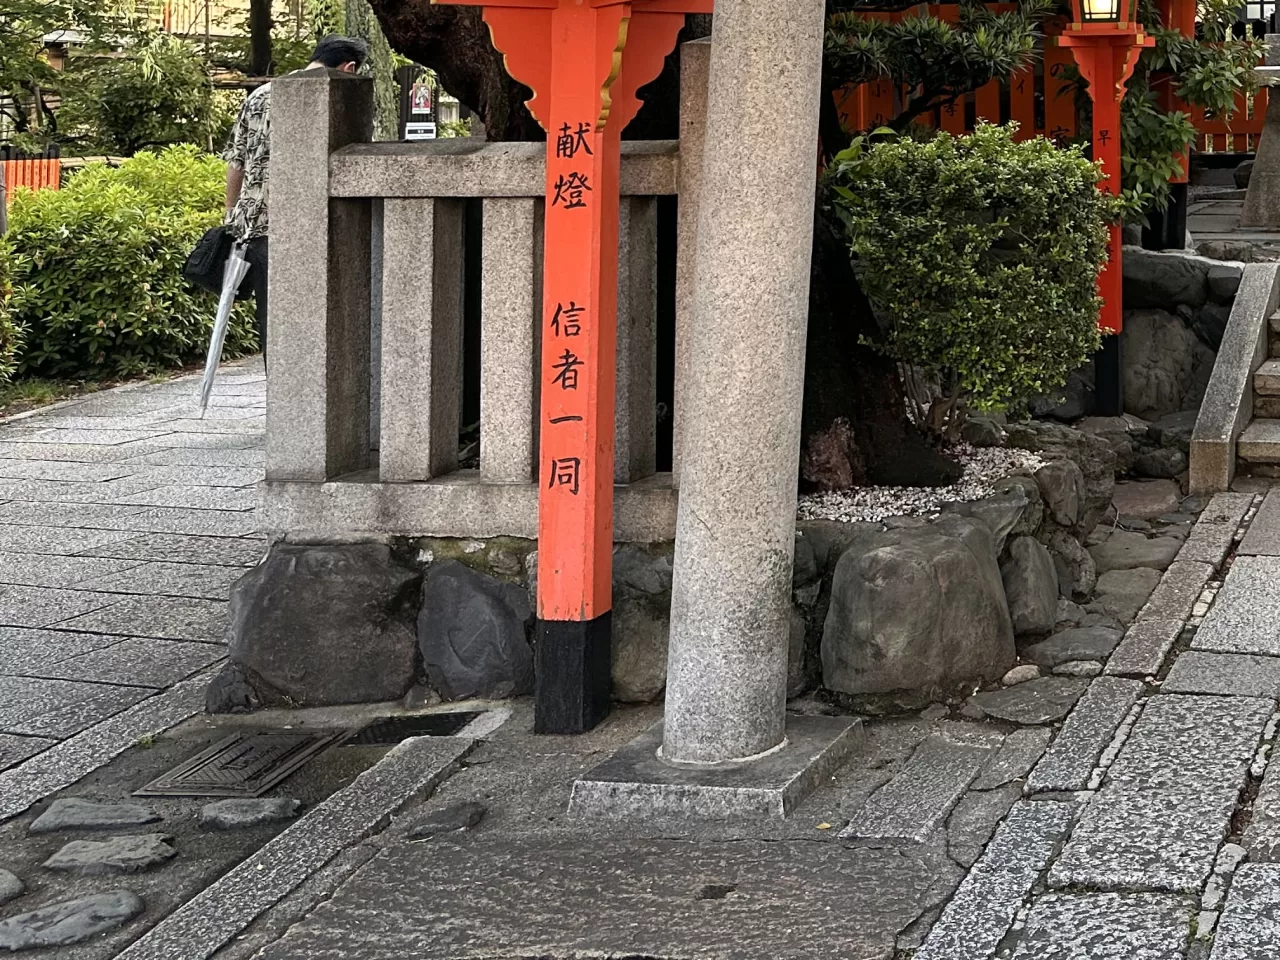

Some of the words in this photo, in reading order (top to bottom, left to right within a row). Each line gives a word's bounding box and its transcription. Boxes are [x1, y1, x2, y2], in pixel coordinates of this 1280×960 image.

[551, 121, 594, 210] 献燈
[548, 301, 586, 496] 信者一同
